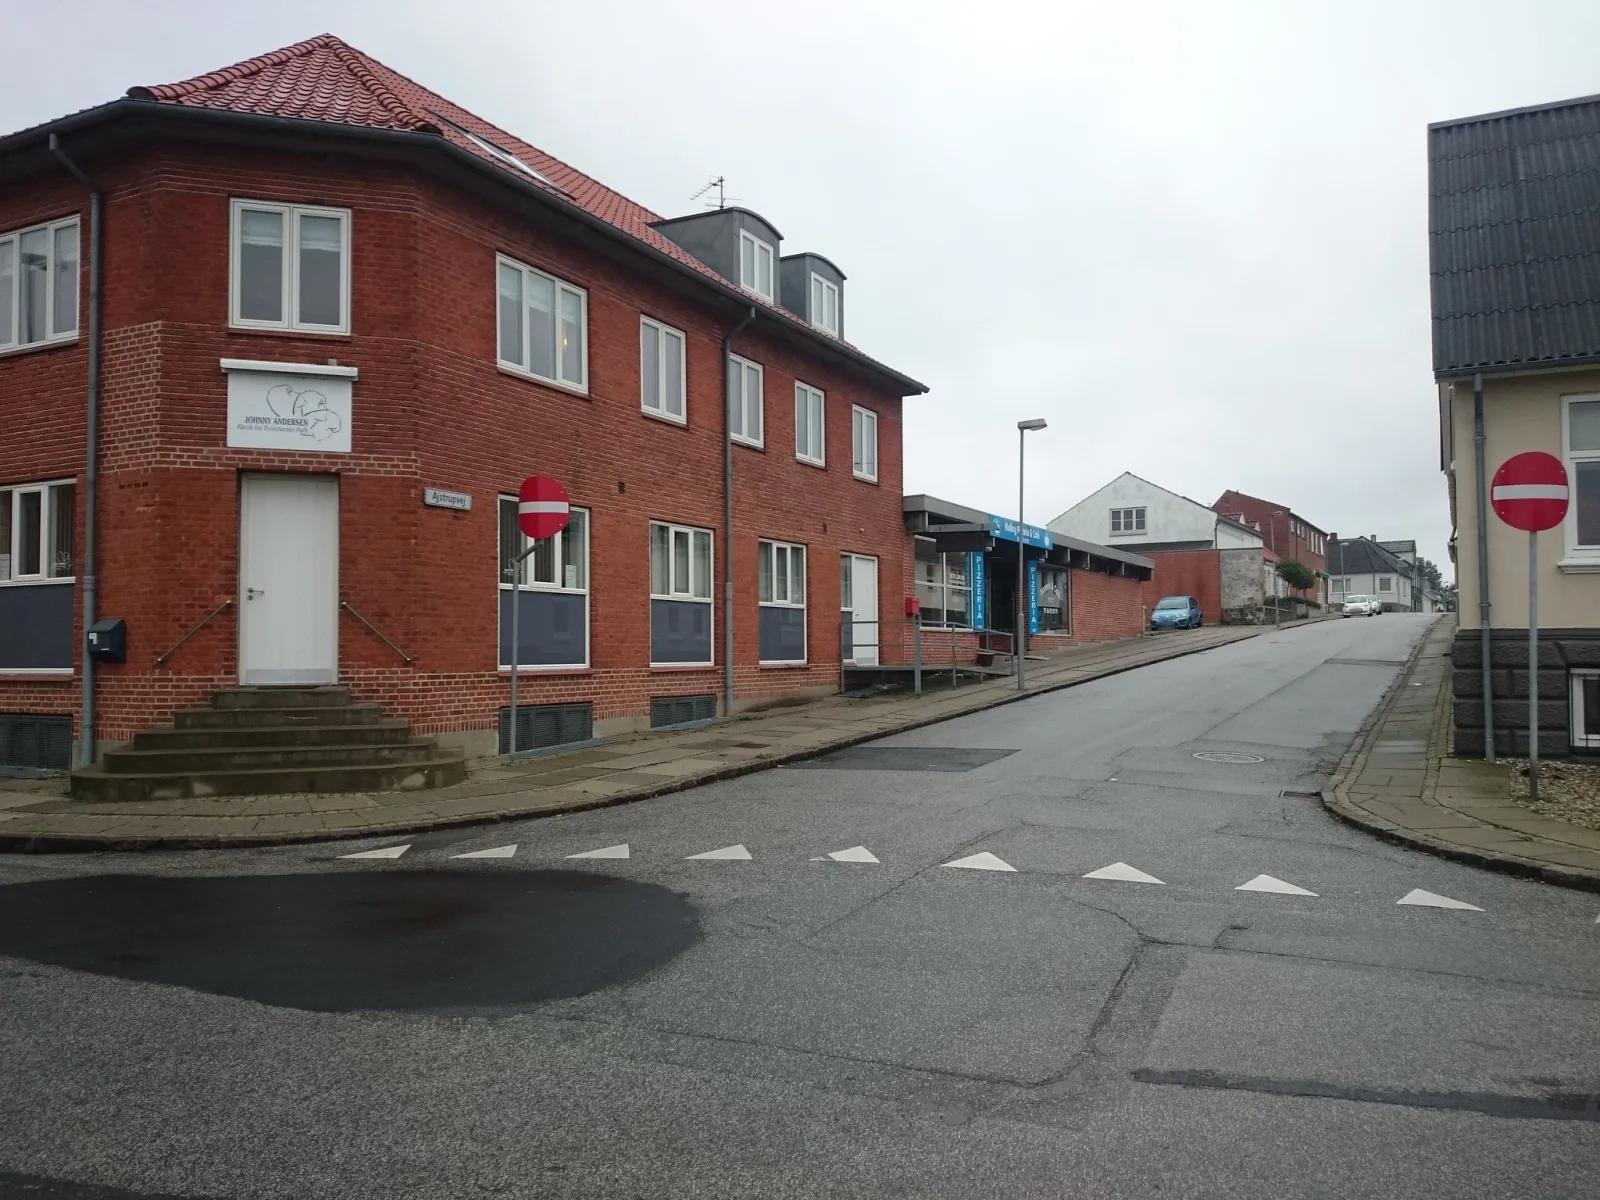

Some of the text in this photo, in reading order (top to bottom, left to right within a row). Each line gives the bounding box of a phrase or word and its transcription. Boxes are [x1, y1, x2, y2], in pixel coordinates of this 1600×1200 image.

[244, 416, 308, 426] JOHNNY ANDERSEN
[432, 492, 466, 506] Ajstrupvej
